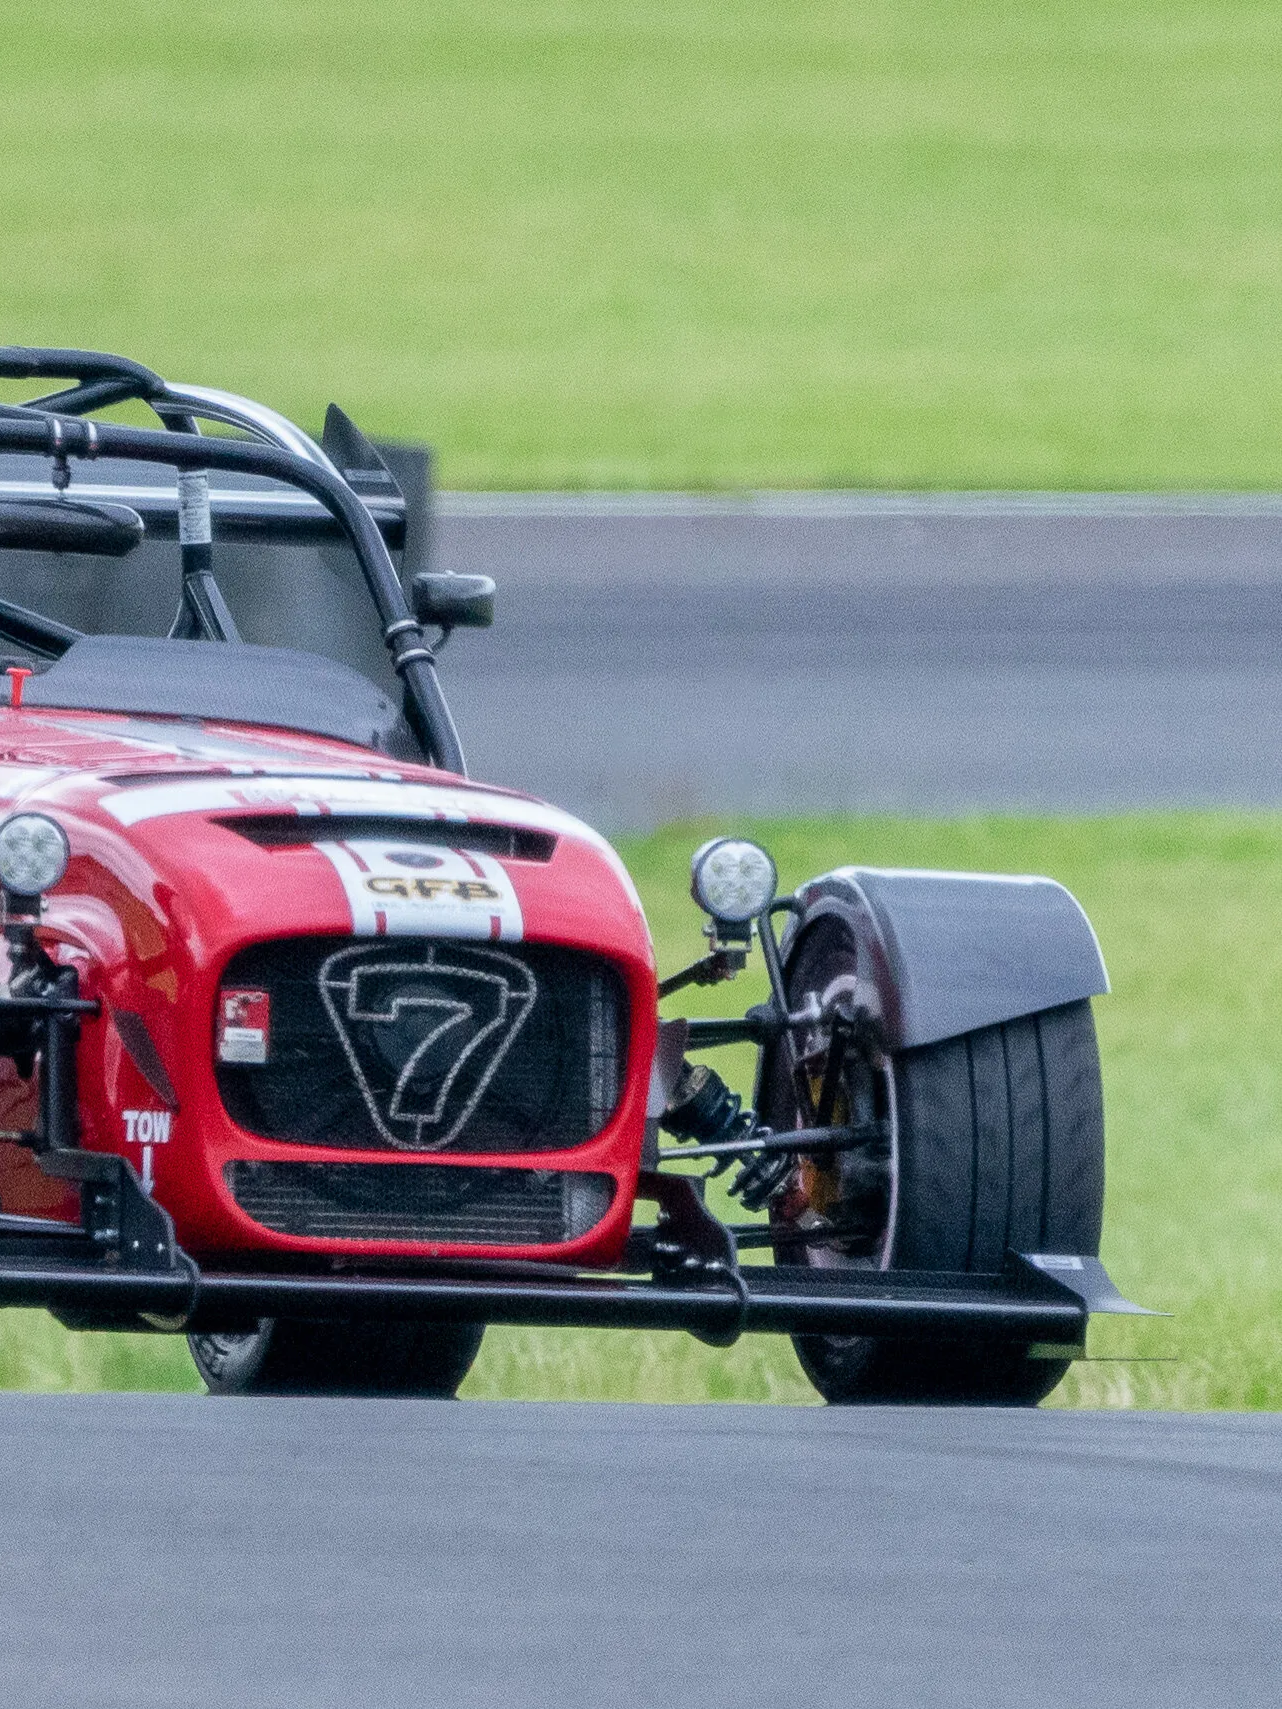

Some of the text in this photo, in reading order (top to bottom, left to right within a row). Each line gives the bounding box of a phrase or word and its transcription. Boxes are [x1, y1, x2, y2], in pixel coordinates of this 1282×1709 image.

[365, 876, 503, 901] GFB
[349, 962, 509, 1123] 7
[122, 1110, 172, 1143] TOW
